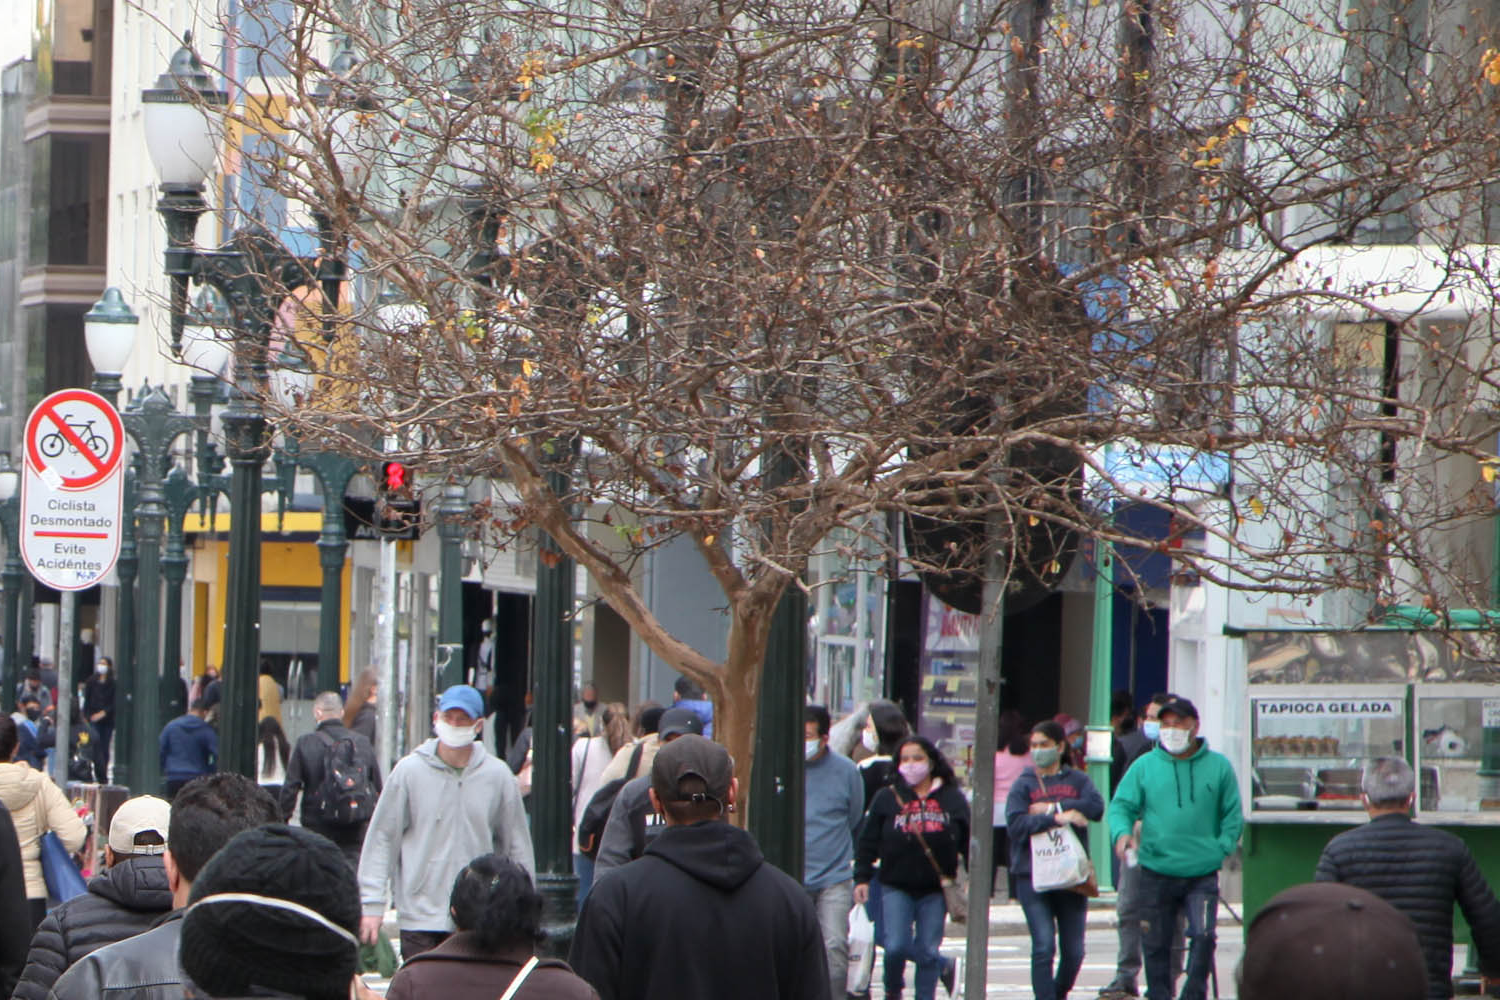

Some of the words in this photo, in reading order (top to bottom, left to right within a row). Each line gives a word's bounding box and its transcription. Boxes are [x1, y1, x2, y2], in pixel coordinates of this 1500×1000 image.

[47, 499, 96, 511] Ciclista
[30, 514, 112, 528] Desmontado
[54, 543, 86, 555] Evite
[1260, 703, 1324, 713] TAPIOCA
[1329, 703, 1392, 713] GELADA
